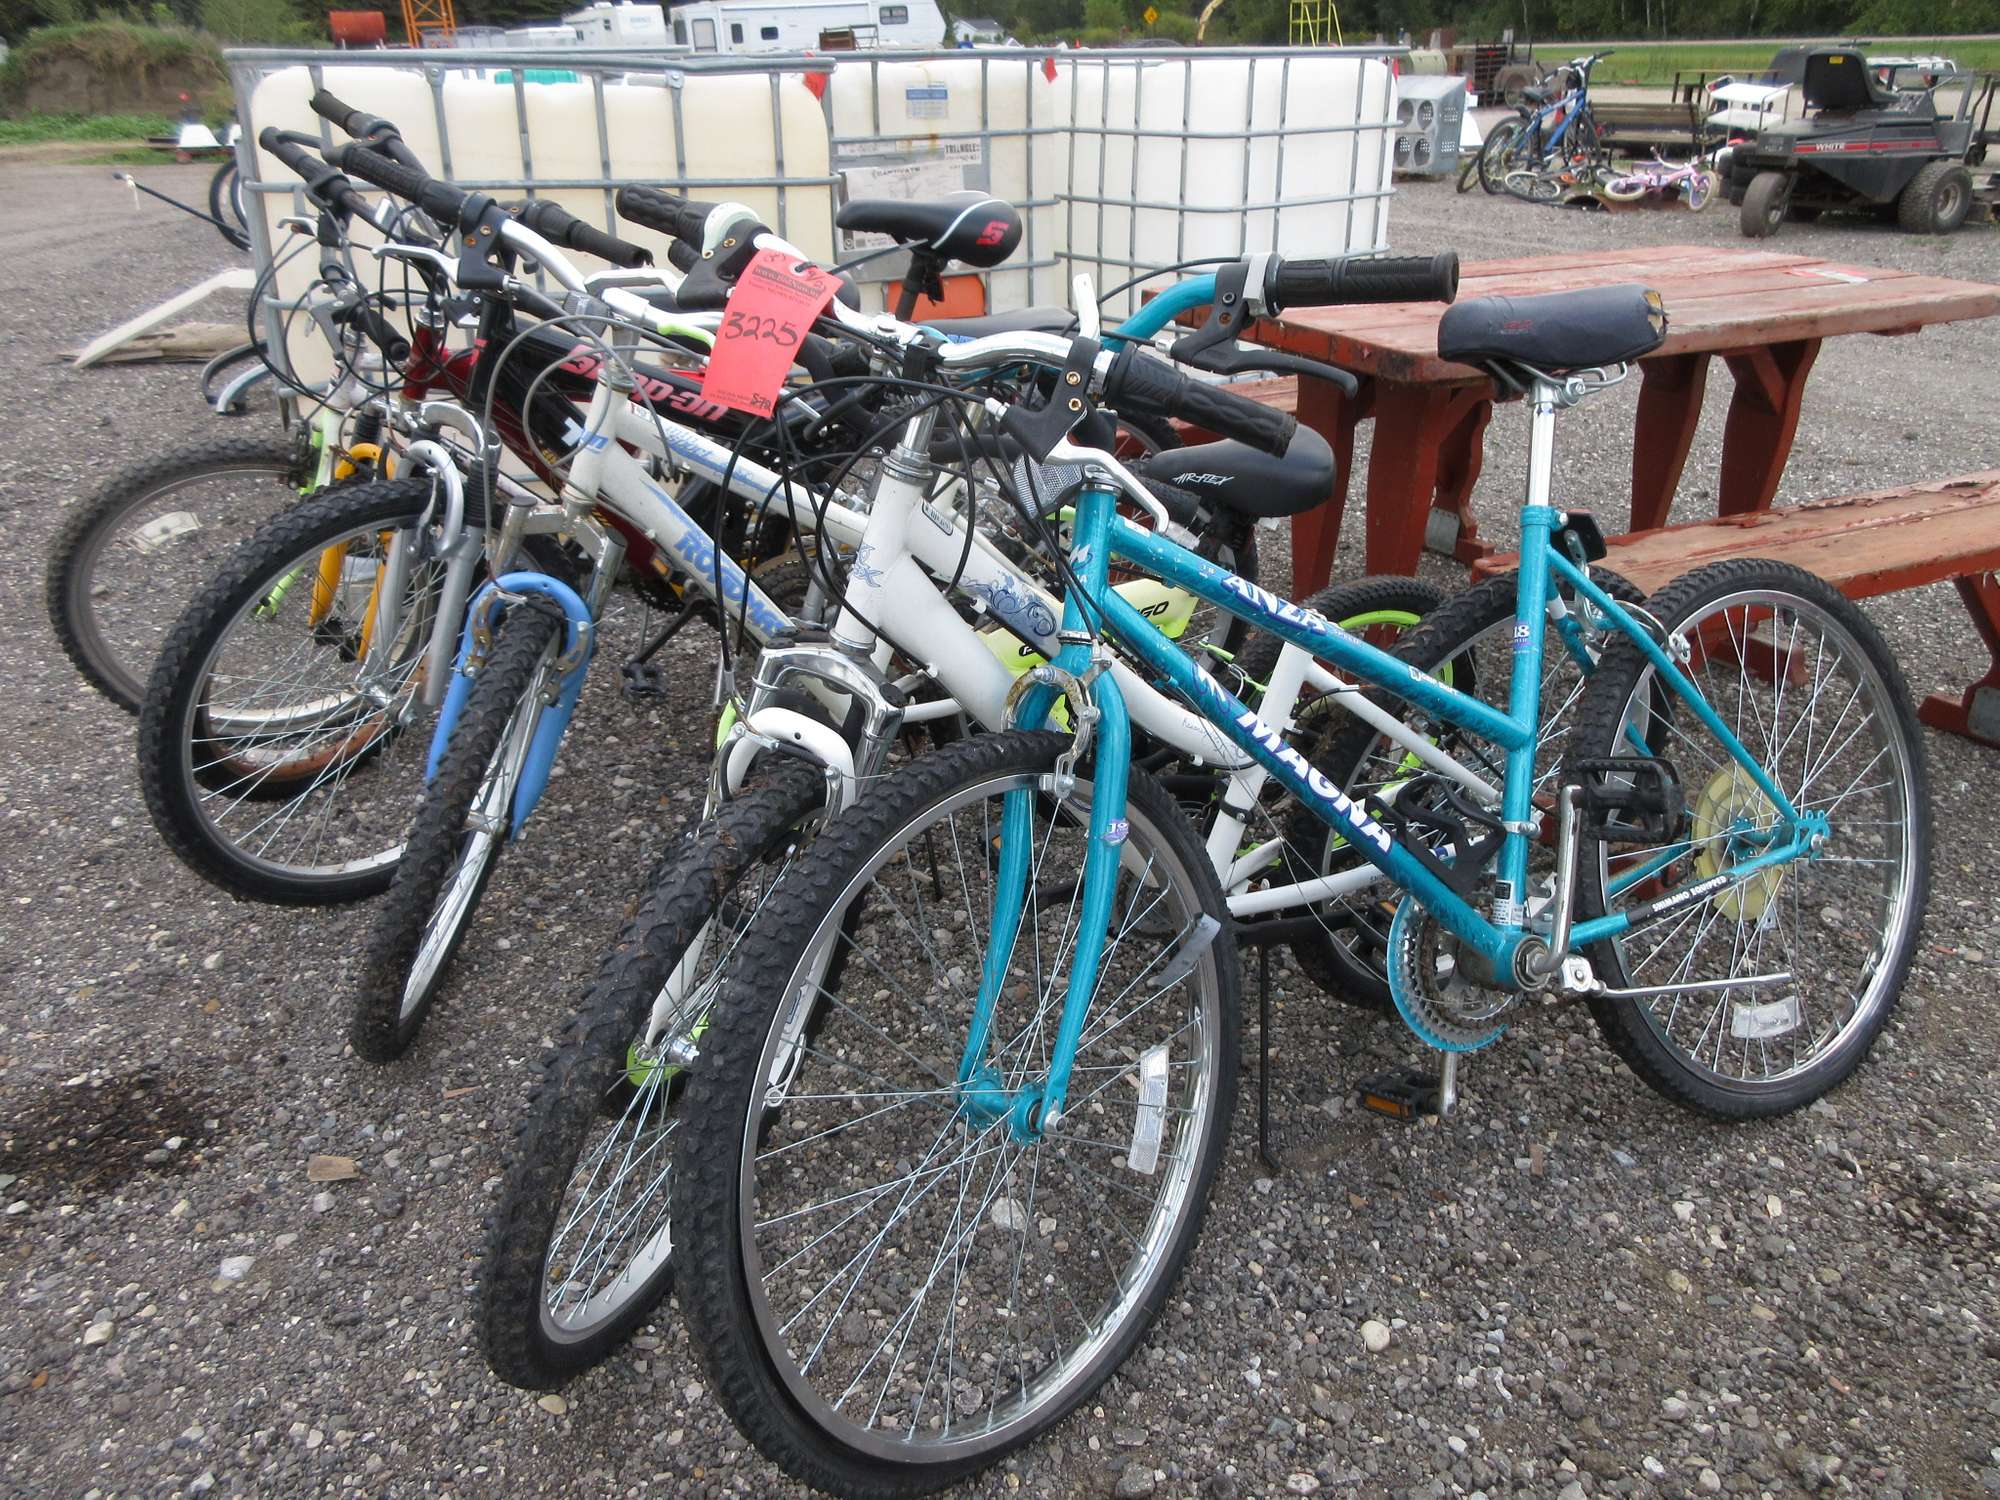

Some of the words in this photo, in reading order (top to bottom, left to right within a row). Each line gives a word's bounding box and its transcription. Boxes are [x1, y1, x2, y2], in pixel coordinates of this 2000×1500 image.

[1815, 142, 1846, 152] WHITE
[725, 311, 798, 346] 3225
[1235, 710, 1393, 855] MAGNA
[1652, 891, 1690, 912] SHIMANO
